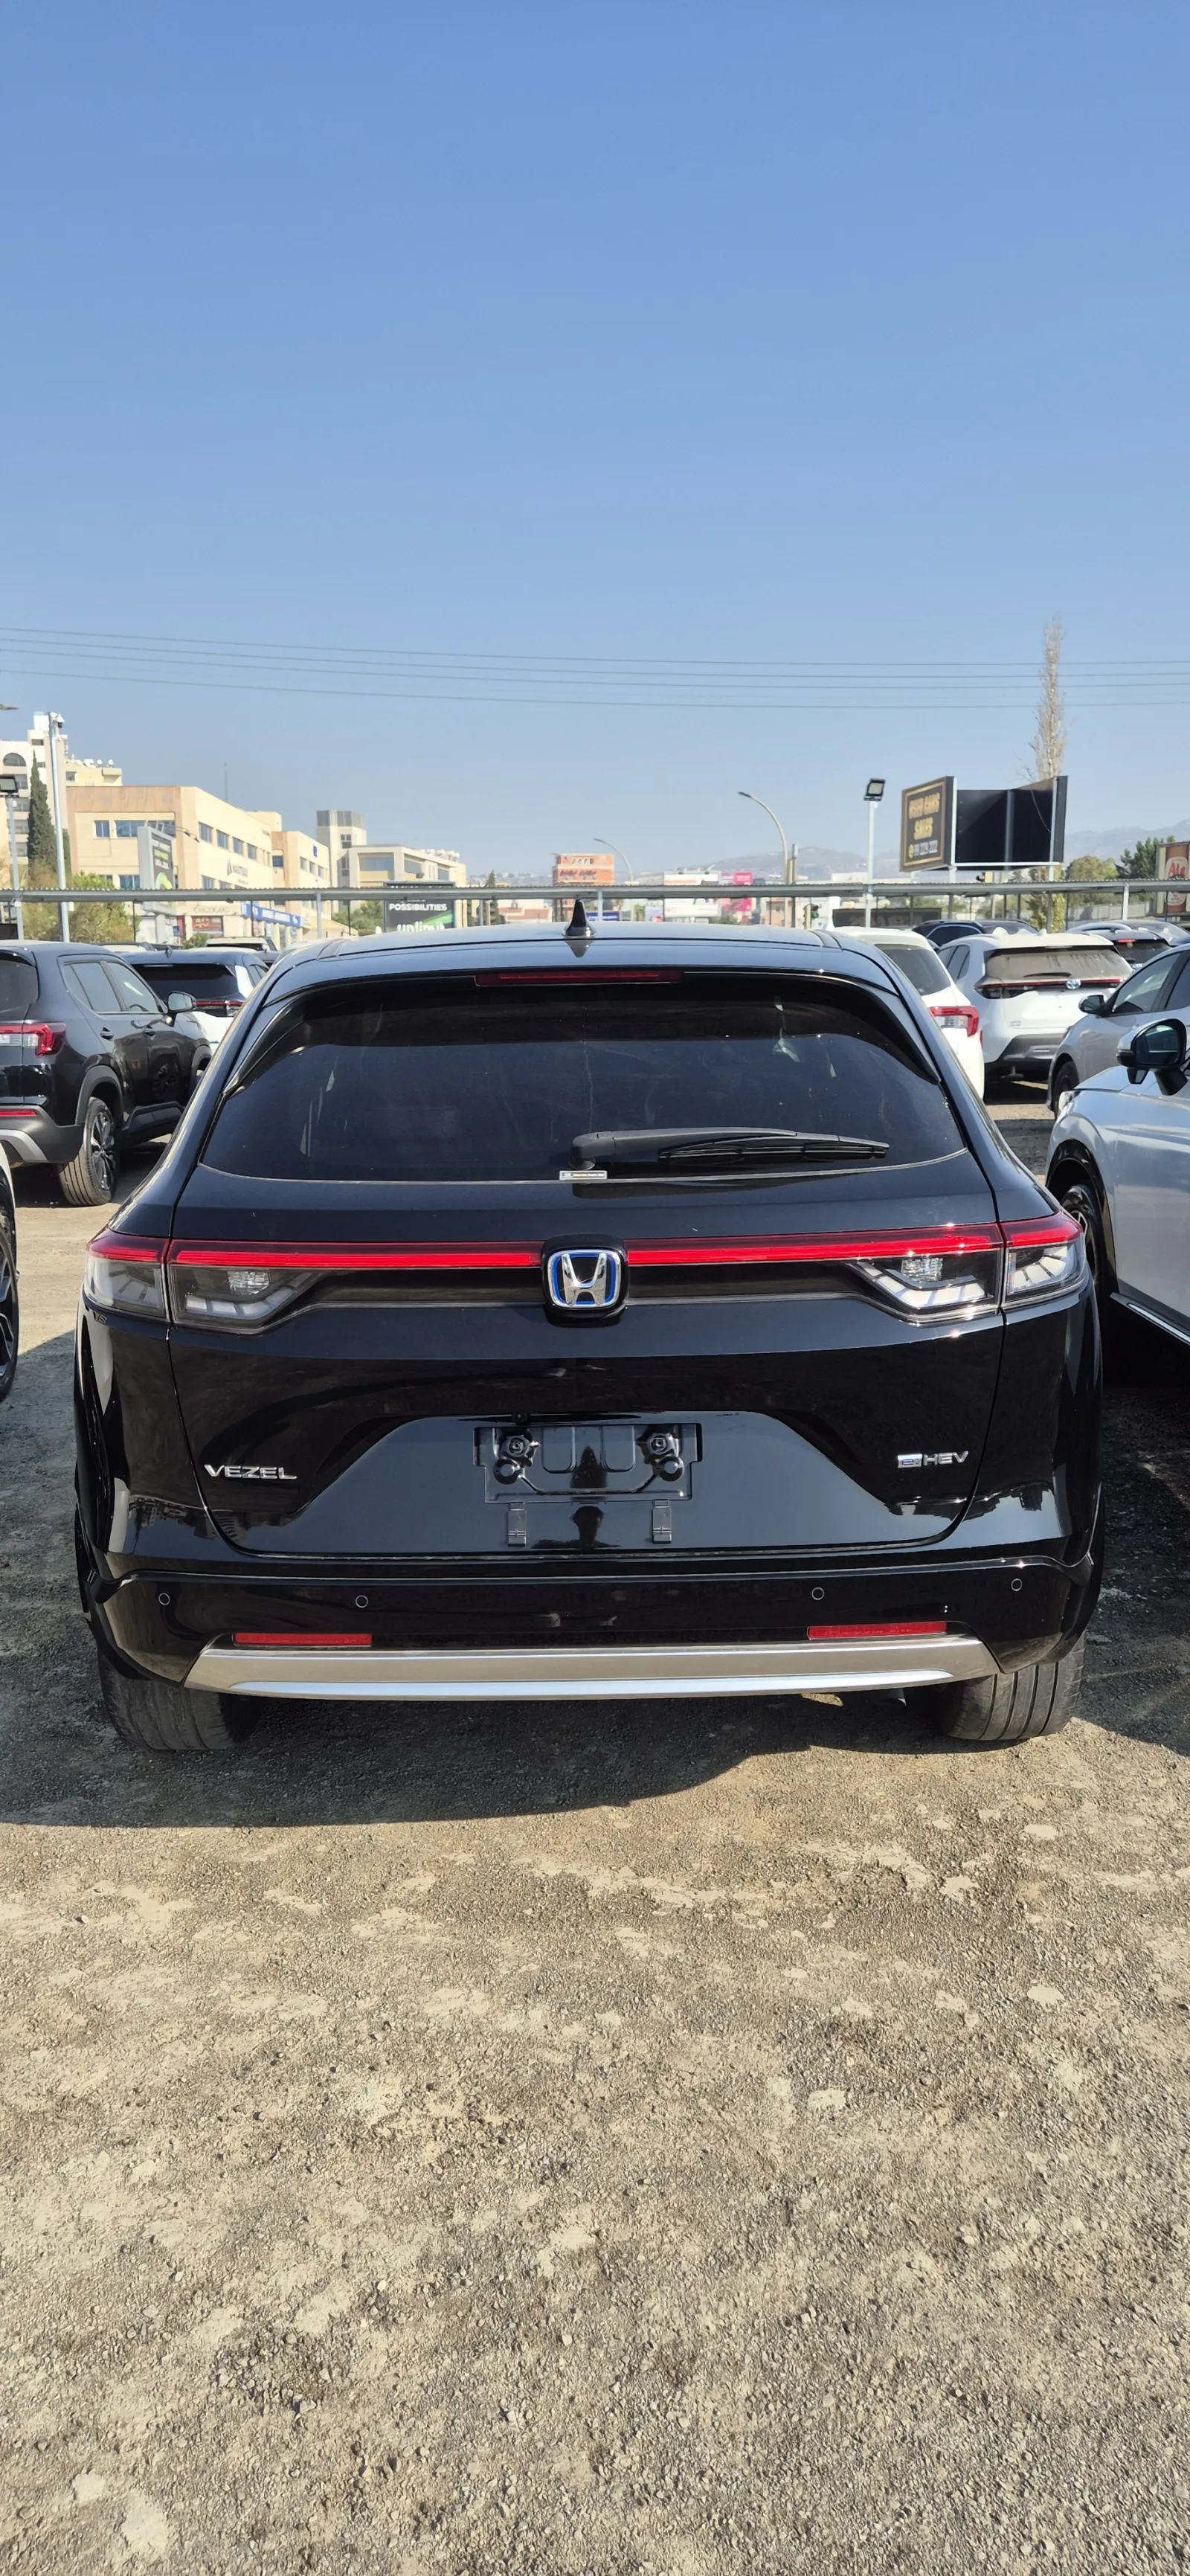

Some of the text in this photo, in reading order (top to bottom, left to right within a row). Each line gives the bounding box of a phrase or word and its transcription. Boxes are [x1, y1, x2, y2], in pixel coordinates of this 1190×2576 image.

[909, 792, 941, 819] USED CARS
[914, 817, 933, 841] SALES
[389, 903, 447, 911] POSSIBILITIES
[204, 1464, 298, 1480] VEZEL
